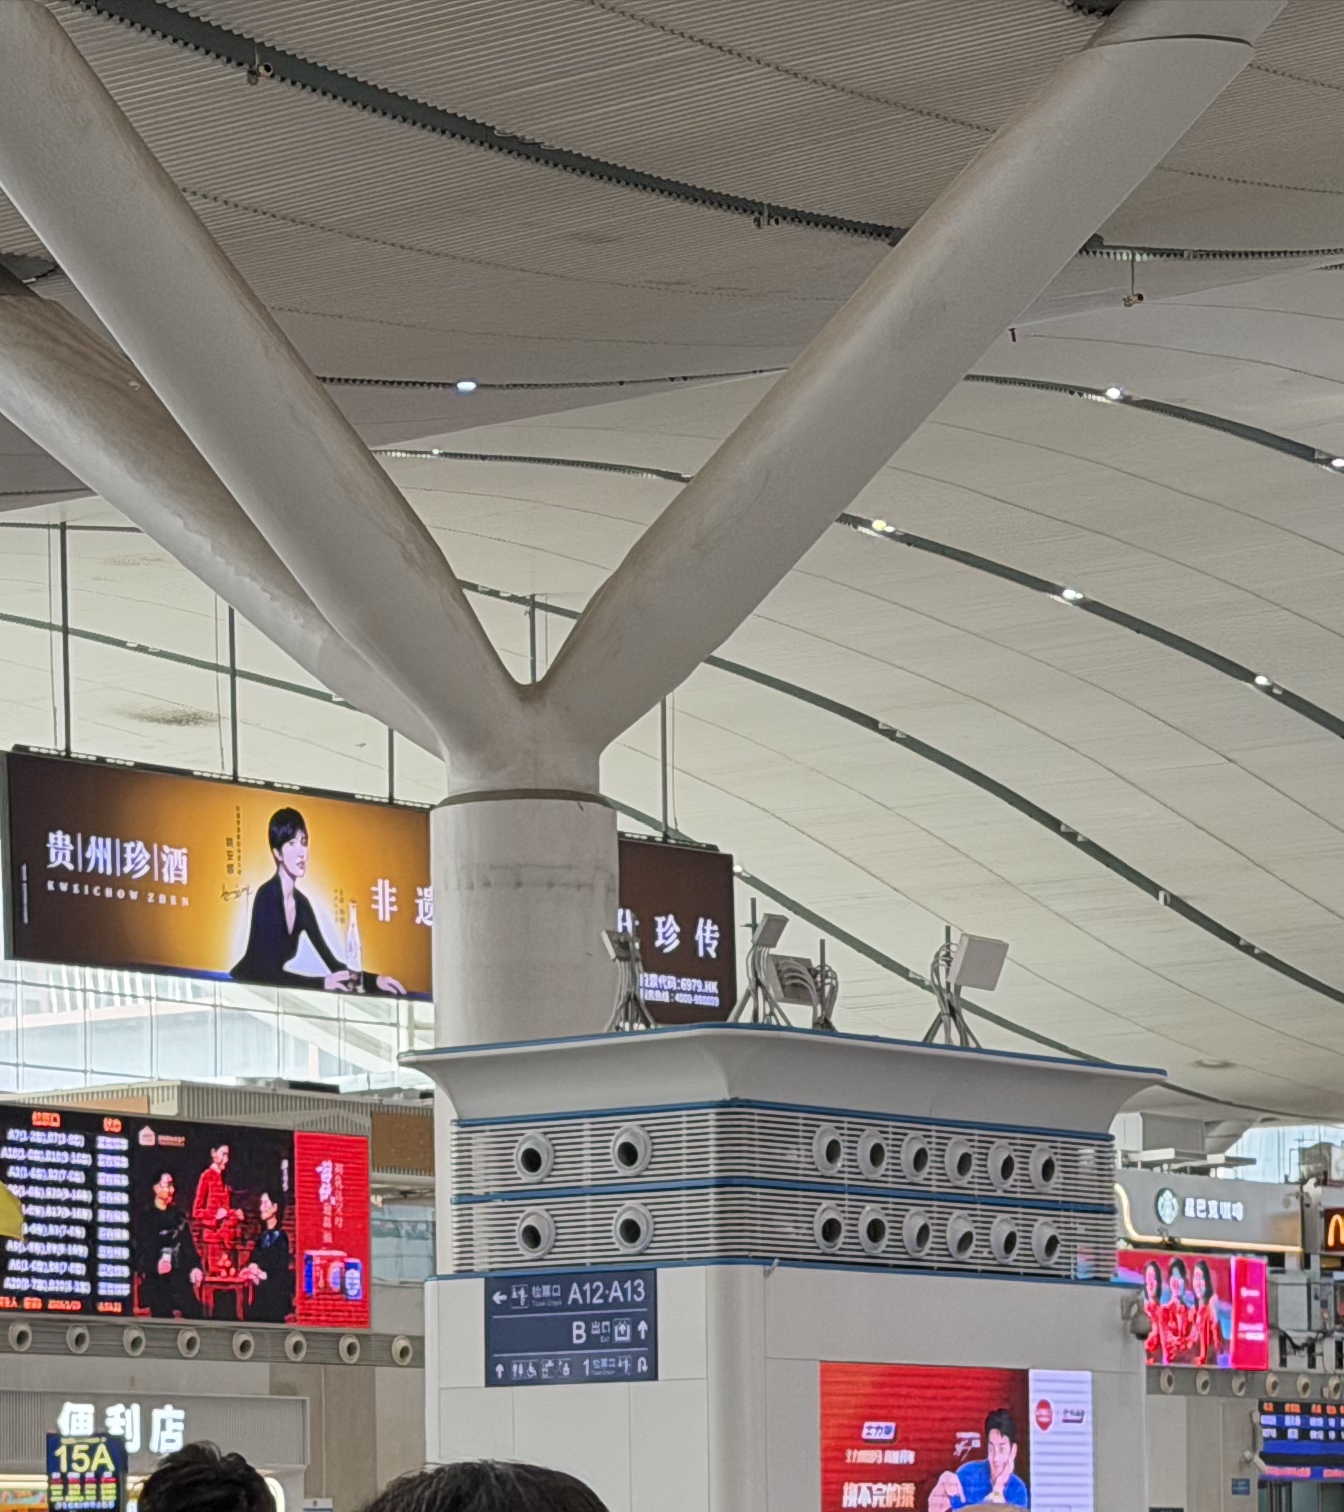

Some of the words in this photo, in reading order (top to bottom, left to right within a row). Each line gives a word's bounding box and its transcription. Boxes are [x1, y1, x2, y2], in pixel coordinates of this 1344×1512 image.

[572, 1321, 587, 1344] B
[591, 1321, 611, 1335] 出口
[583, 1358, 590, 1376] 1
[56, 1402, 185, 1454] 便利店
[54, 1444, 115, 1473] 15A
